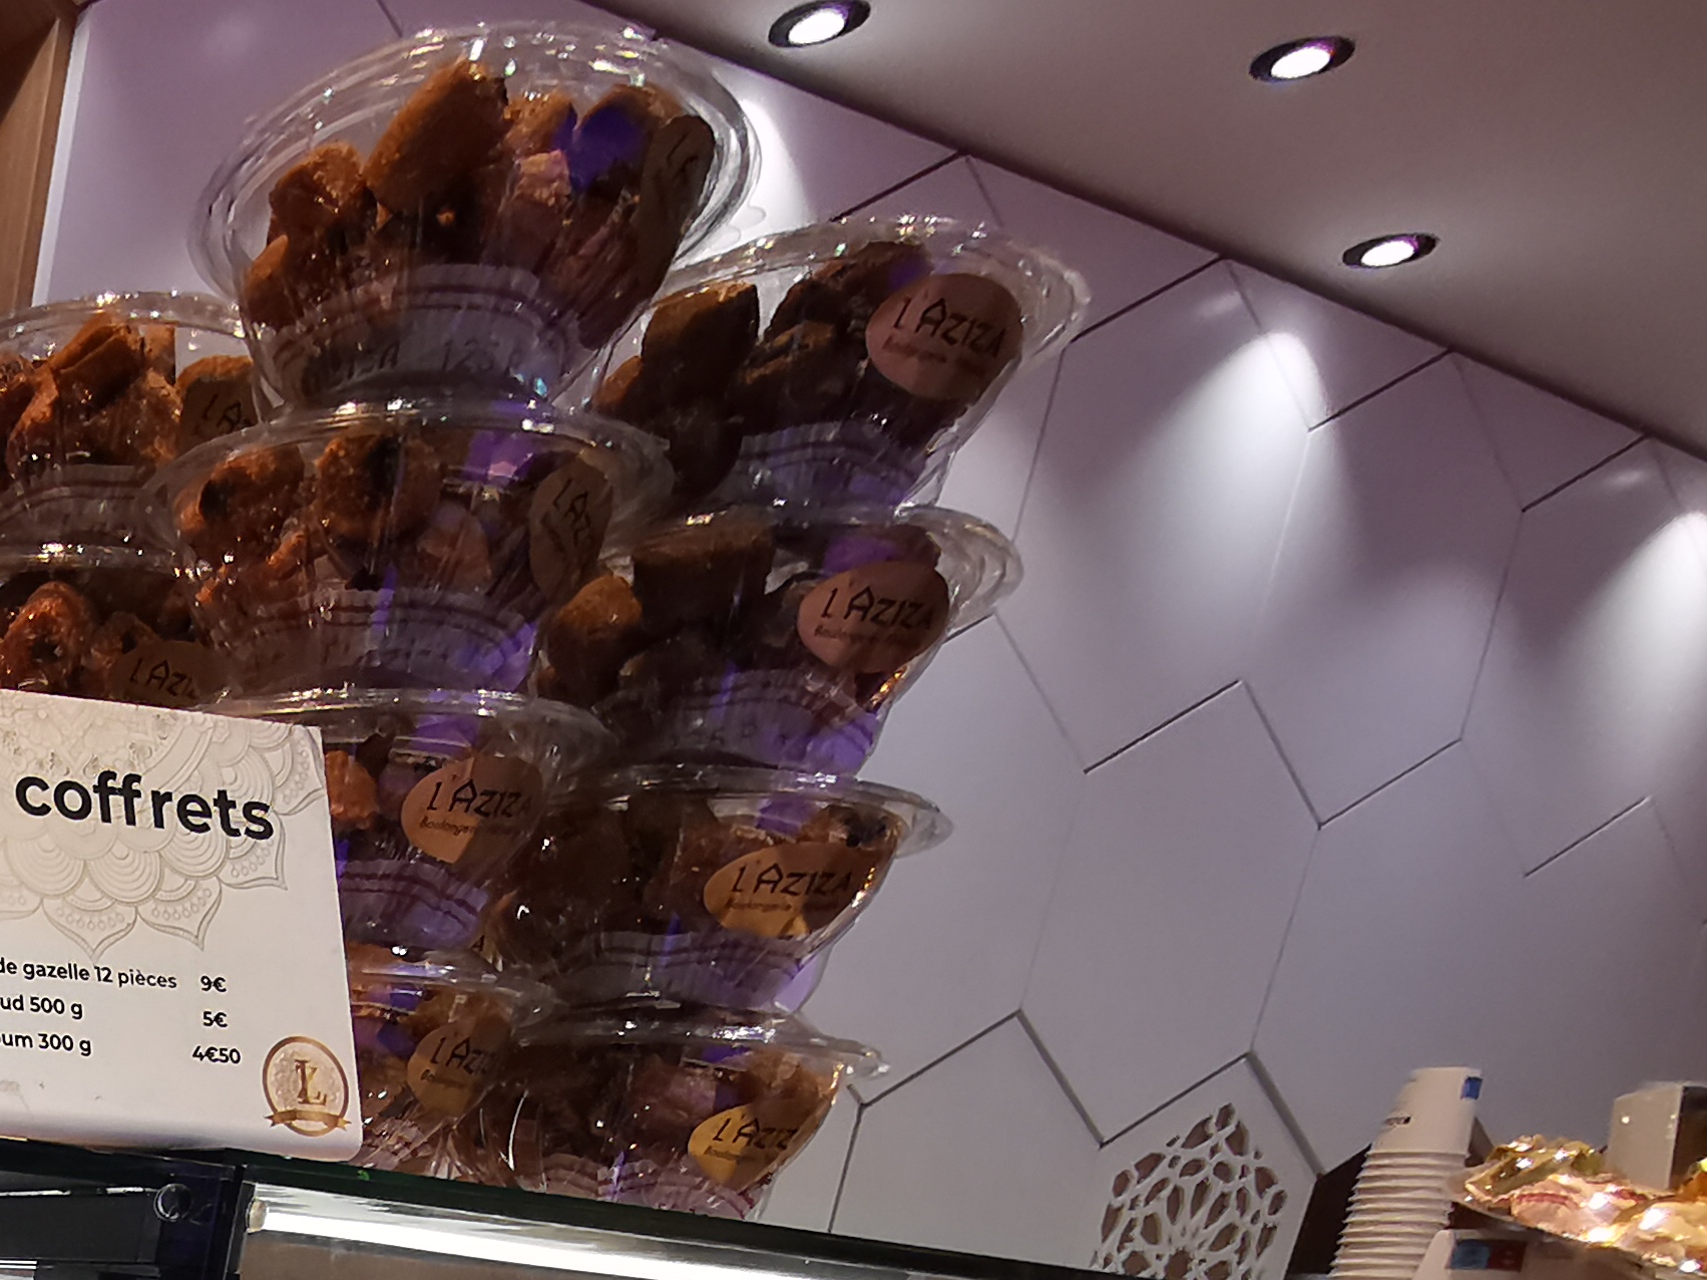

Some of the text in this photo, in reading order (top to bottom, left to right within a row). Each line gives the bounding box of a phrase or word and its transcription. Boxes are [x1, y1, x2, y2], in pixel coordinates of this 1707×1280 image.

[15, 769, 275, 841] coffrets
[22, 962, 91, 981] gazelle
[93, 965, 114, 983] 12
[117, 968, 178, 988] pièces
[199, 975, 227, 993] 9€
[29, 996, 65, 1015] 500
[70, 1002, 84, 1020] g
[202, 1010, 228, 1028] 5€
[37, 1033, 74, 1052] 300
[78, 1039, 92, 1057] g
[191, 1045, 242, 1065] 4€50
